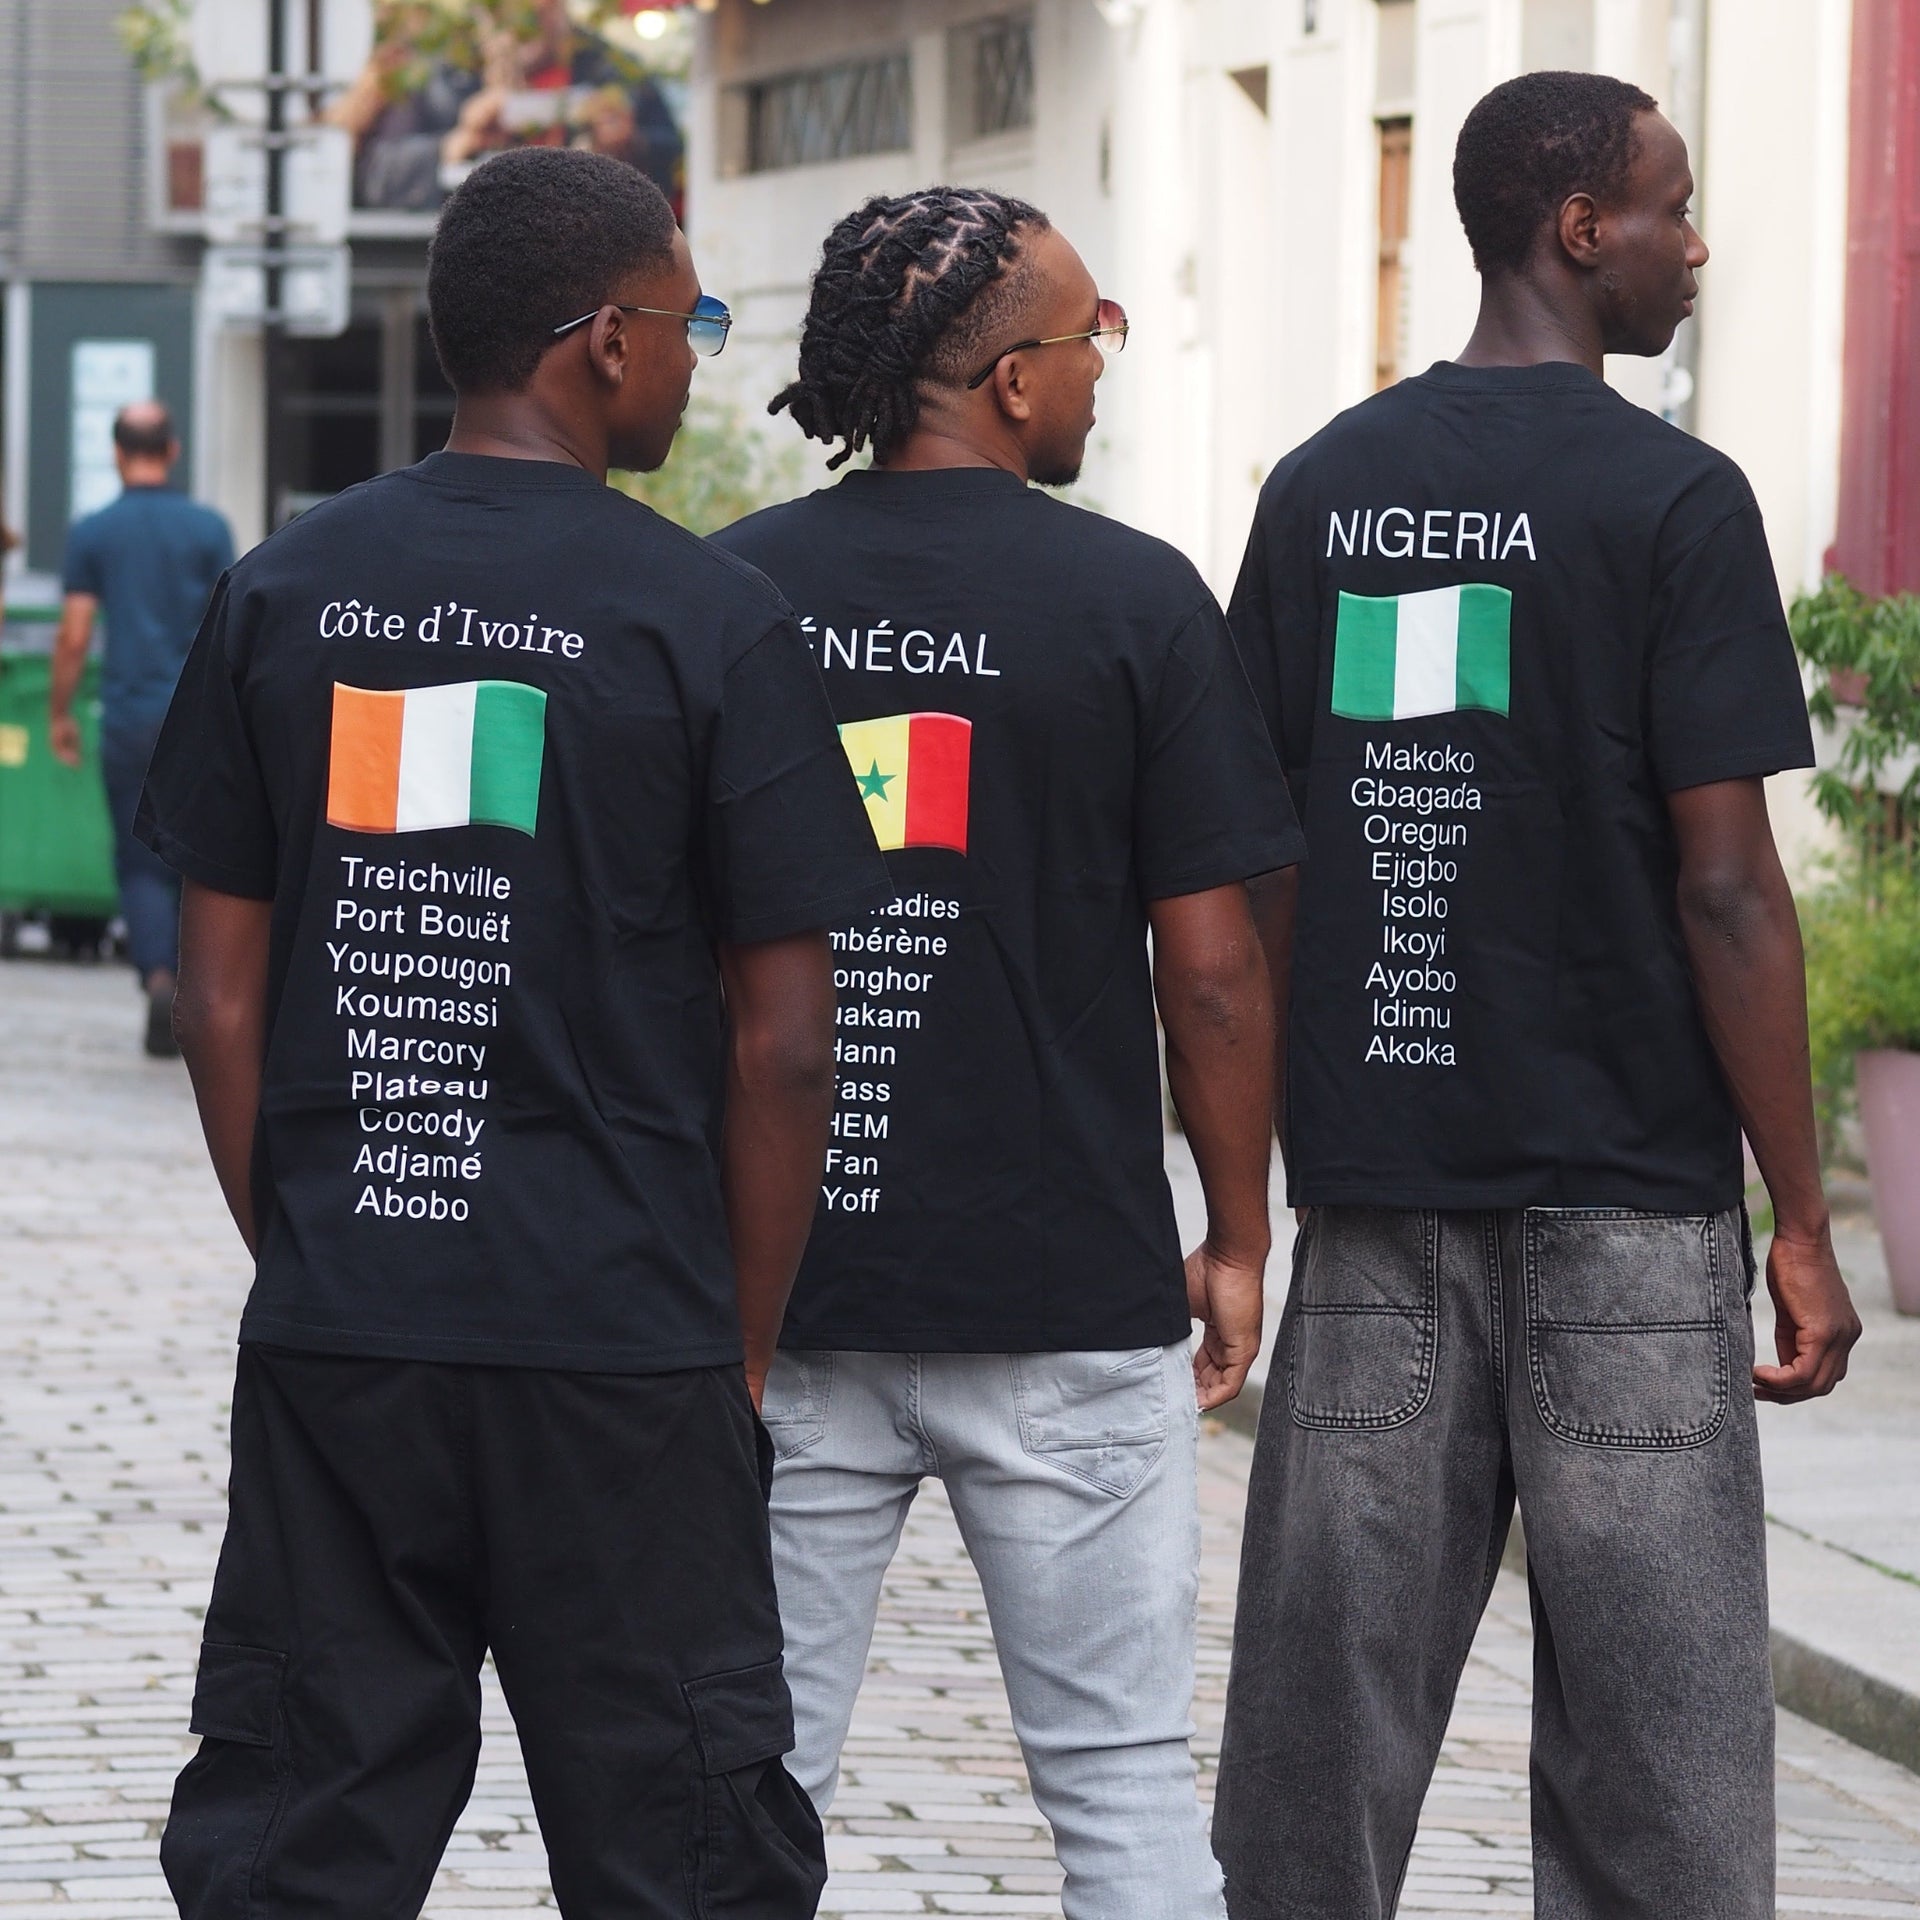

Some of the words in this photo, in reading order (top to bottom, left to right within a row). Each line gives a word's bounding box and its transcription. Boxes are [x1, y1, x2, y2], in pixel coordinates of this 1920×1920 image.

[1326, 506, 1537, 561] NIGERIA
[319, 598, 405, 641] Côte
[1365, 741, 1475, 774] Makoko
[1351, 777, 1482, 816] Gbagada
[1363, 814, 1467, 852] Oregun
[340, 856, 511, 900] Treichville
[1372, 851, 1458, 889] Ejigbo
[335, 899, 406, 934] Port
[420, 904, 511, 943] Bouët
[870, 892, 960, 920] adies
[1383, 888, 1448, 919] Isolo
[1383, 925, 1446, 962] Ikoyi
[326, 941, 511, 990] Youpougon
[1364, 961, 1457, 998] Ayobo
[336, 985, 497, 1027] Koumassi
[1373, 998, 1451, 1029] Idimu
[347, 1028, 486, 1072] Marcory
[1364, 1034, 1457, 1066] Akoka
[351, 1070, 488, 1102] Plateau
[834, 1074, 891, 1102] ass
[359, 1107, 485, 1147] Cocody
[352, 1143, 482, 1183] Adjamé
[825, 1148, 878, 1176] Fan
[354, 1184, 469, 1222] Abobo
[821, 1185, 881, 1213] Yoff
